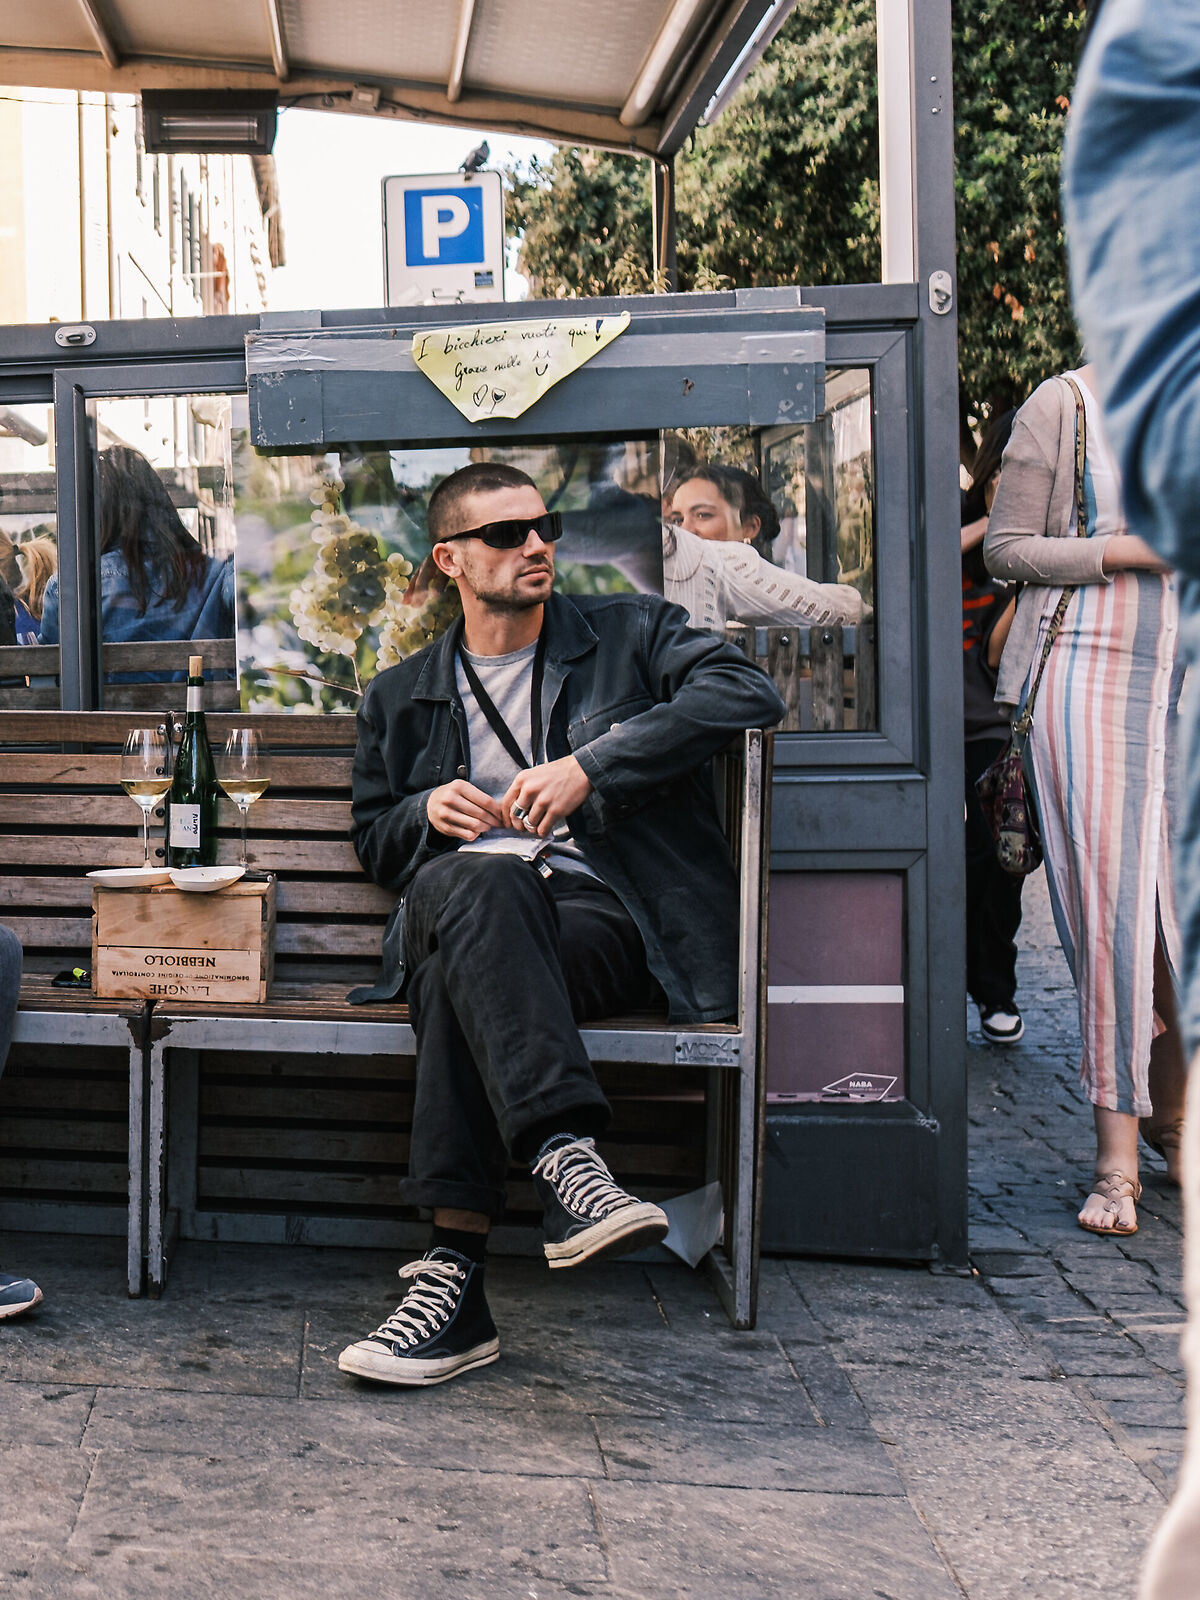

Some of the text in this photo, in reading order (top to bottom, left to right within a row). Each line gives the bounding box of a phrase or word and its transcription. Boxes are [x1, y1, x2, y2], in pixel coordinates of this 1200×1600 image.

[421, 195, 470, 258] P
[418, 336, 432, 361] I
[443, 328, 508, 355] bicchieri
[520, 323, 557, 340] vuoti
[454, 356, 521, 391] Grazie mille
[144, 954, 216, 967] NEBBIOLO
[111, 970, 155, 978] CONTROLLATA
[150, 984, 210, 996] LANGHE
[849, 1080, 872, 1088] NABA
